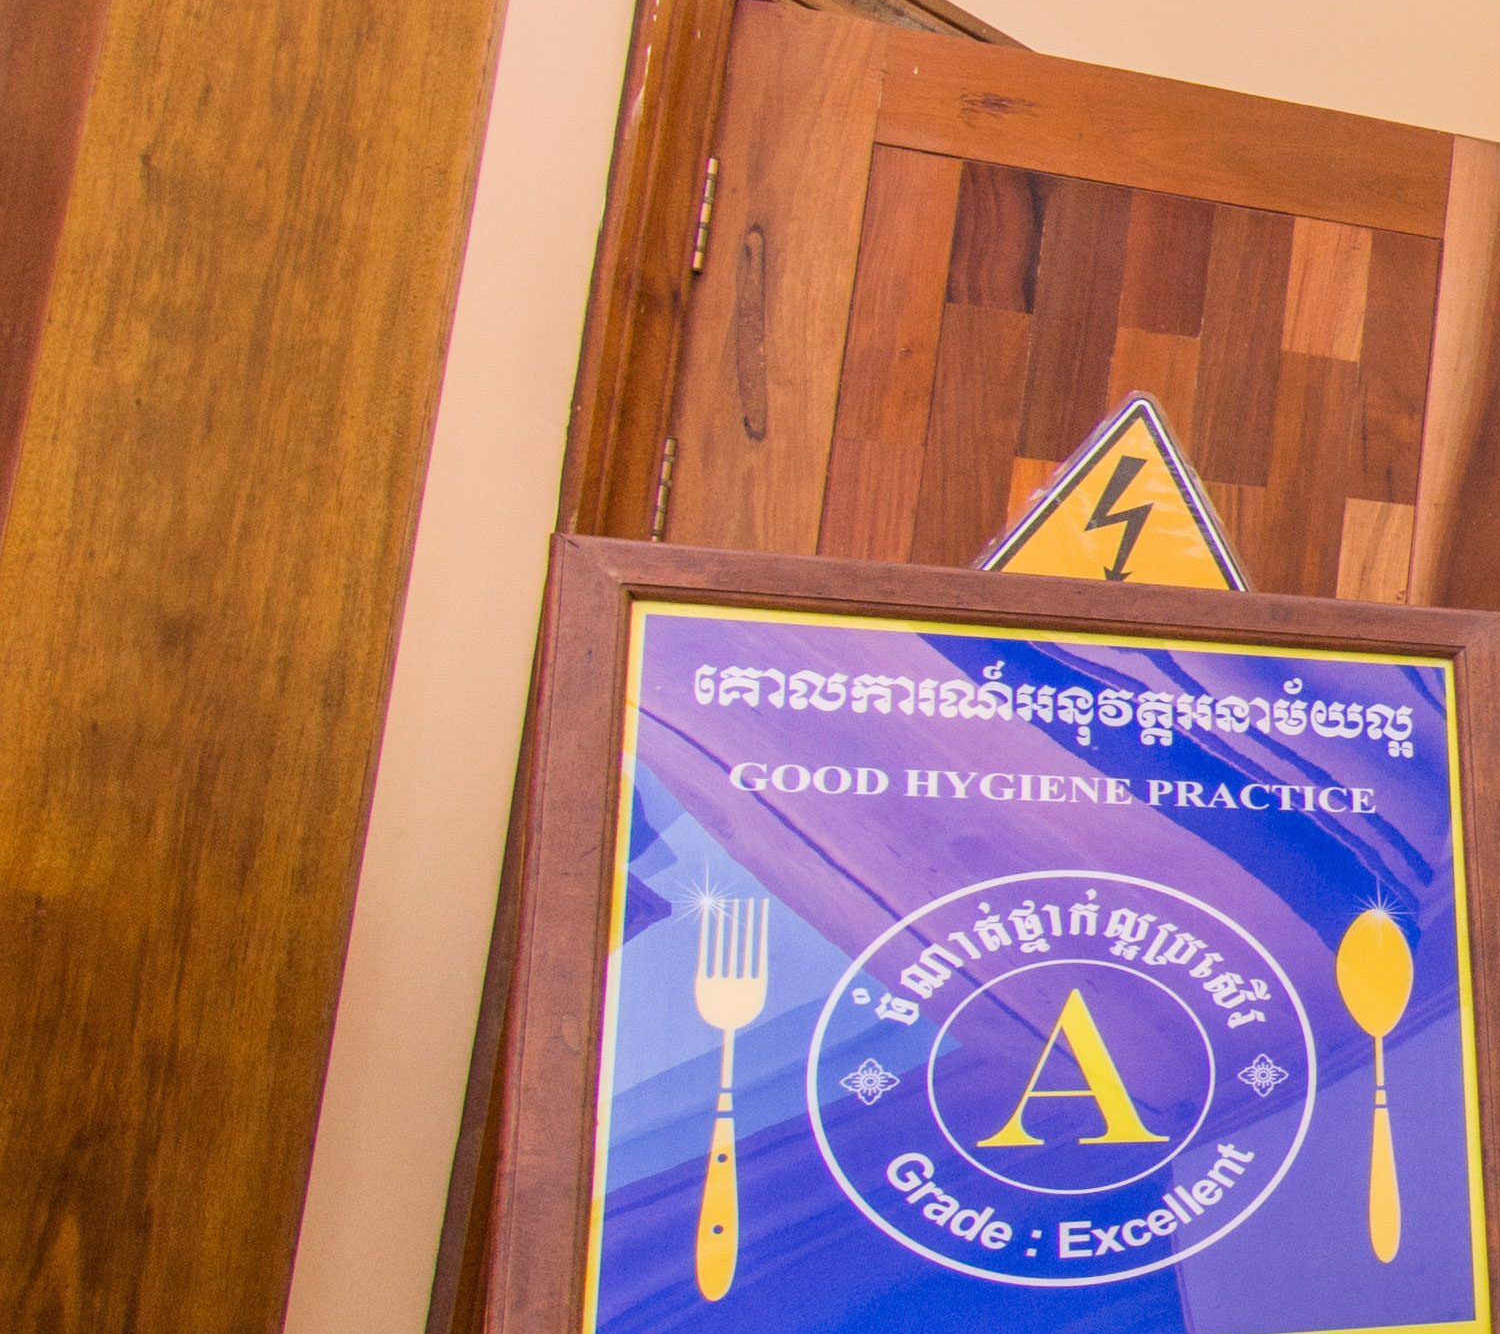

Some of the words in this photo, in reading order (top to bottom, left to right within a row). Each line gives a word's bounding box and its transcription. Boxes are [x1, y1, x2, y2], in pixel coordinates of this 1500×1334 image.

[694, 660, 1414, 758] គោលការណ៍អនុវត្តអនាម័យល្អ
[729, 761, 889, 797] GOOD
[904, 769, 1133, 808] HYGIENE
[1147, 778, 1377, 815] PRACTICE
[975, 988, 1170, 1148] A
[885, 1151, 1013, 1250] Grade
[1058, 1142, 1254, 1259] Excellent
